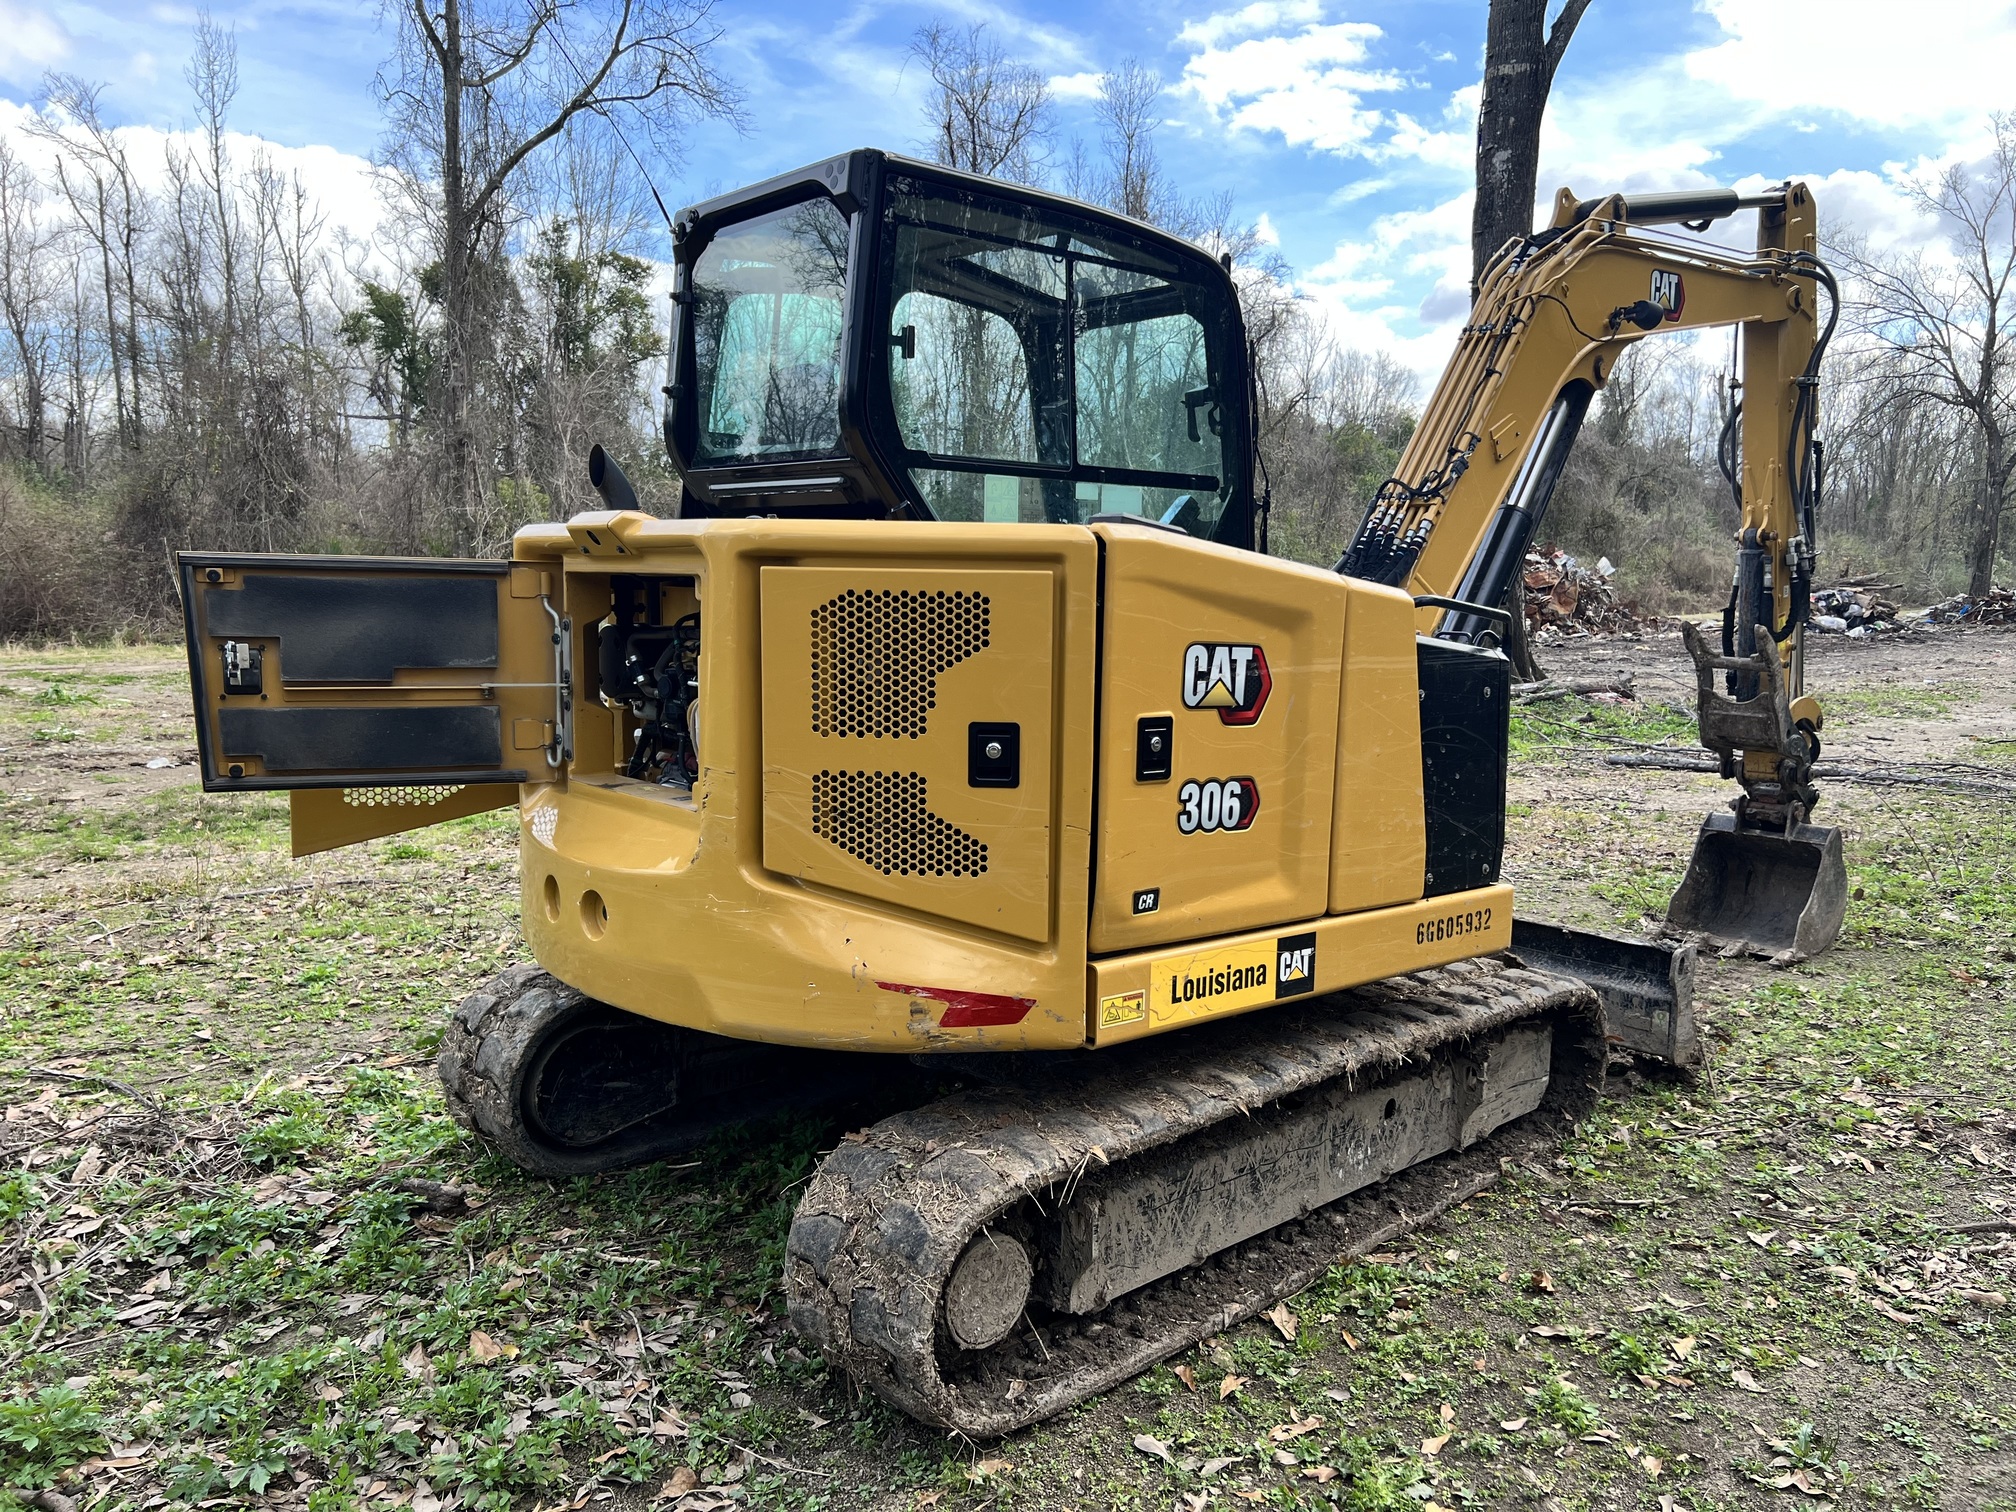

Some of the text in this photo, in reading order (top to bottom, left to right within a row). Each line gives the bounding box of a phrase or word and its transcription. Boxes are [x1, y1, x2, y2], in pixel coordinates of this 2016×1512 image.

[1651, 270, 1678, 310] CAT
[1183, 644, 1253, 707] CAT
[1179, 781, 1241, 832] 306
[1138, 893, 1154, 910] CR
[1416, 907, 1491, 945] 6G605932
[1171, 947, 1312, 1004] Louisiana CAT
